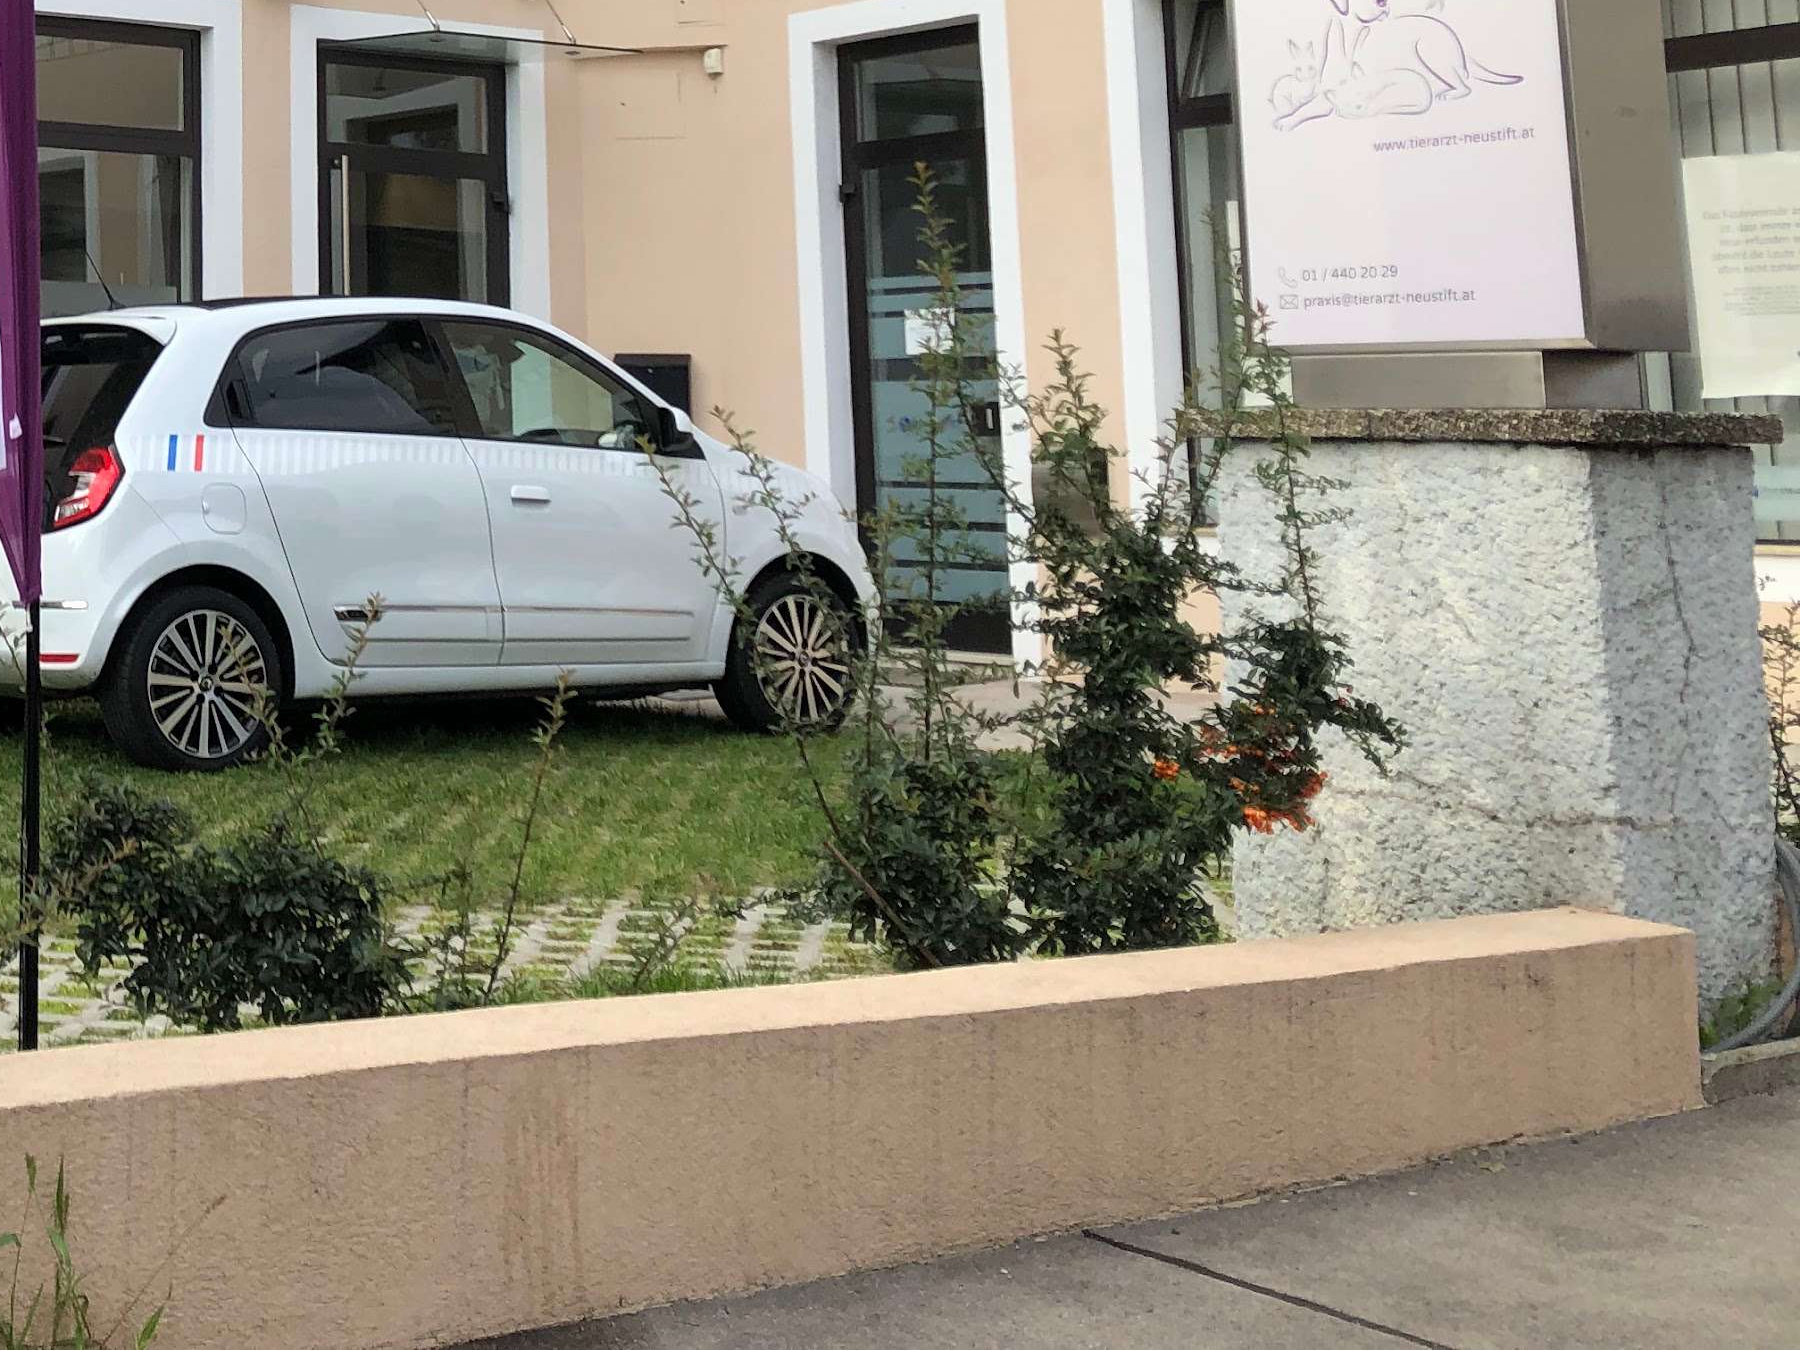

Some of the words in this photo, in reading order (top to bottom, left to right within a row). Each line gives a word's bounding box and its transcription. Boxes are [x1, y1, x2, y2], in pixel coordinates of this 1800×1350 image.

[1373, 127, 1534, 152] www.tierarzt-neustift.at
[1302, 269, 1317, 282] 01
[1331, 267, 1357, 280] 440
[1360, 266, 1378, 279] 20
[1381, 265, 1398, 278] 29
[1304, 288, 1476, 310] praxis@tierarzt-neustift.at
